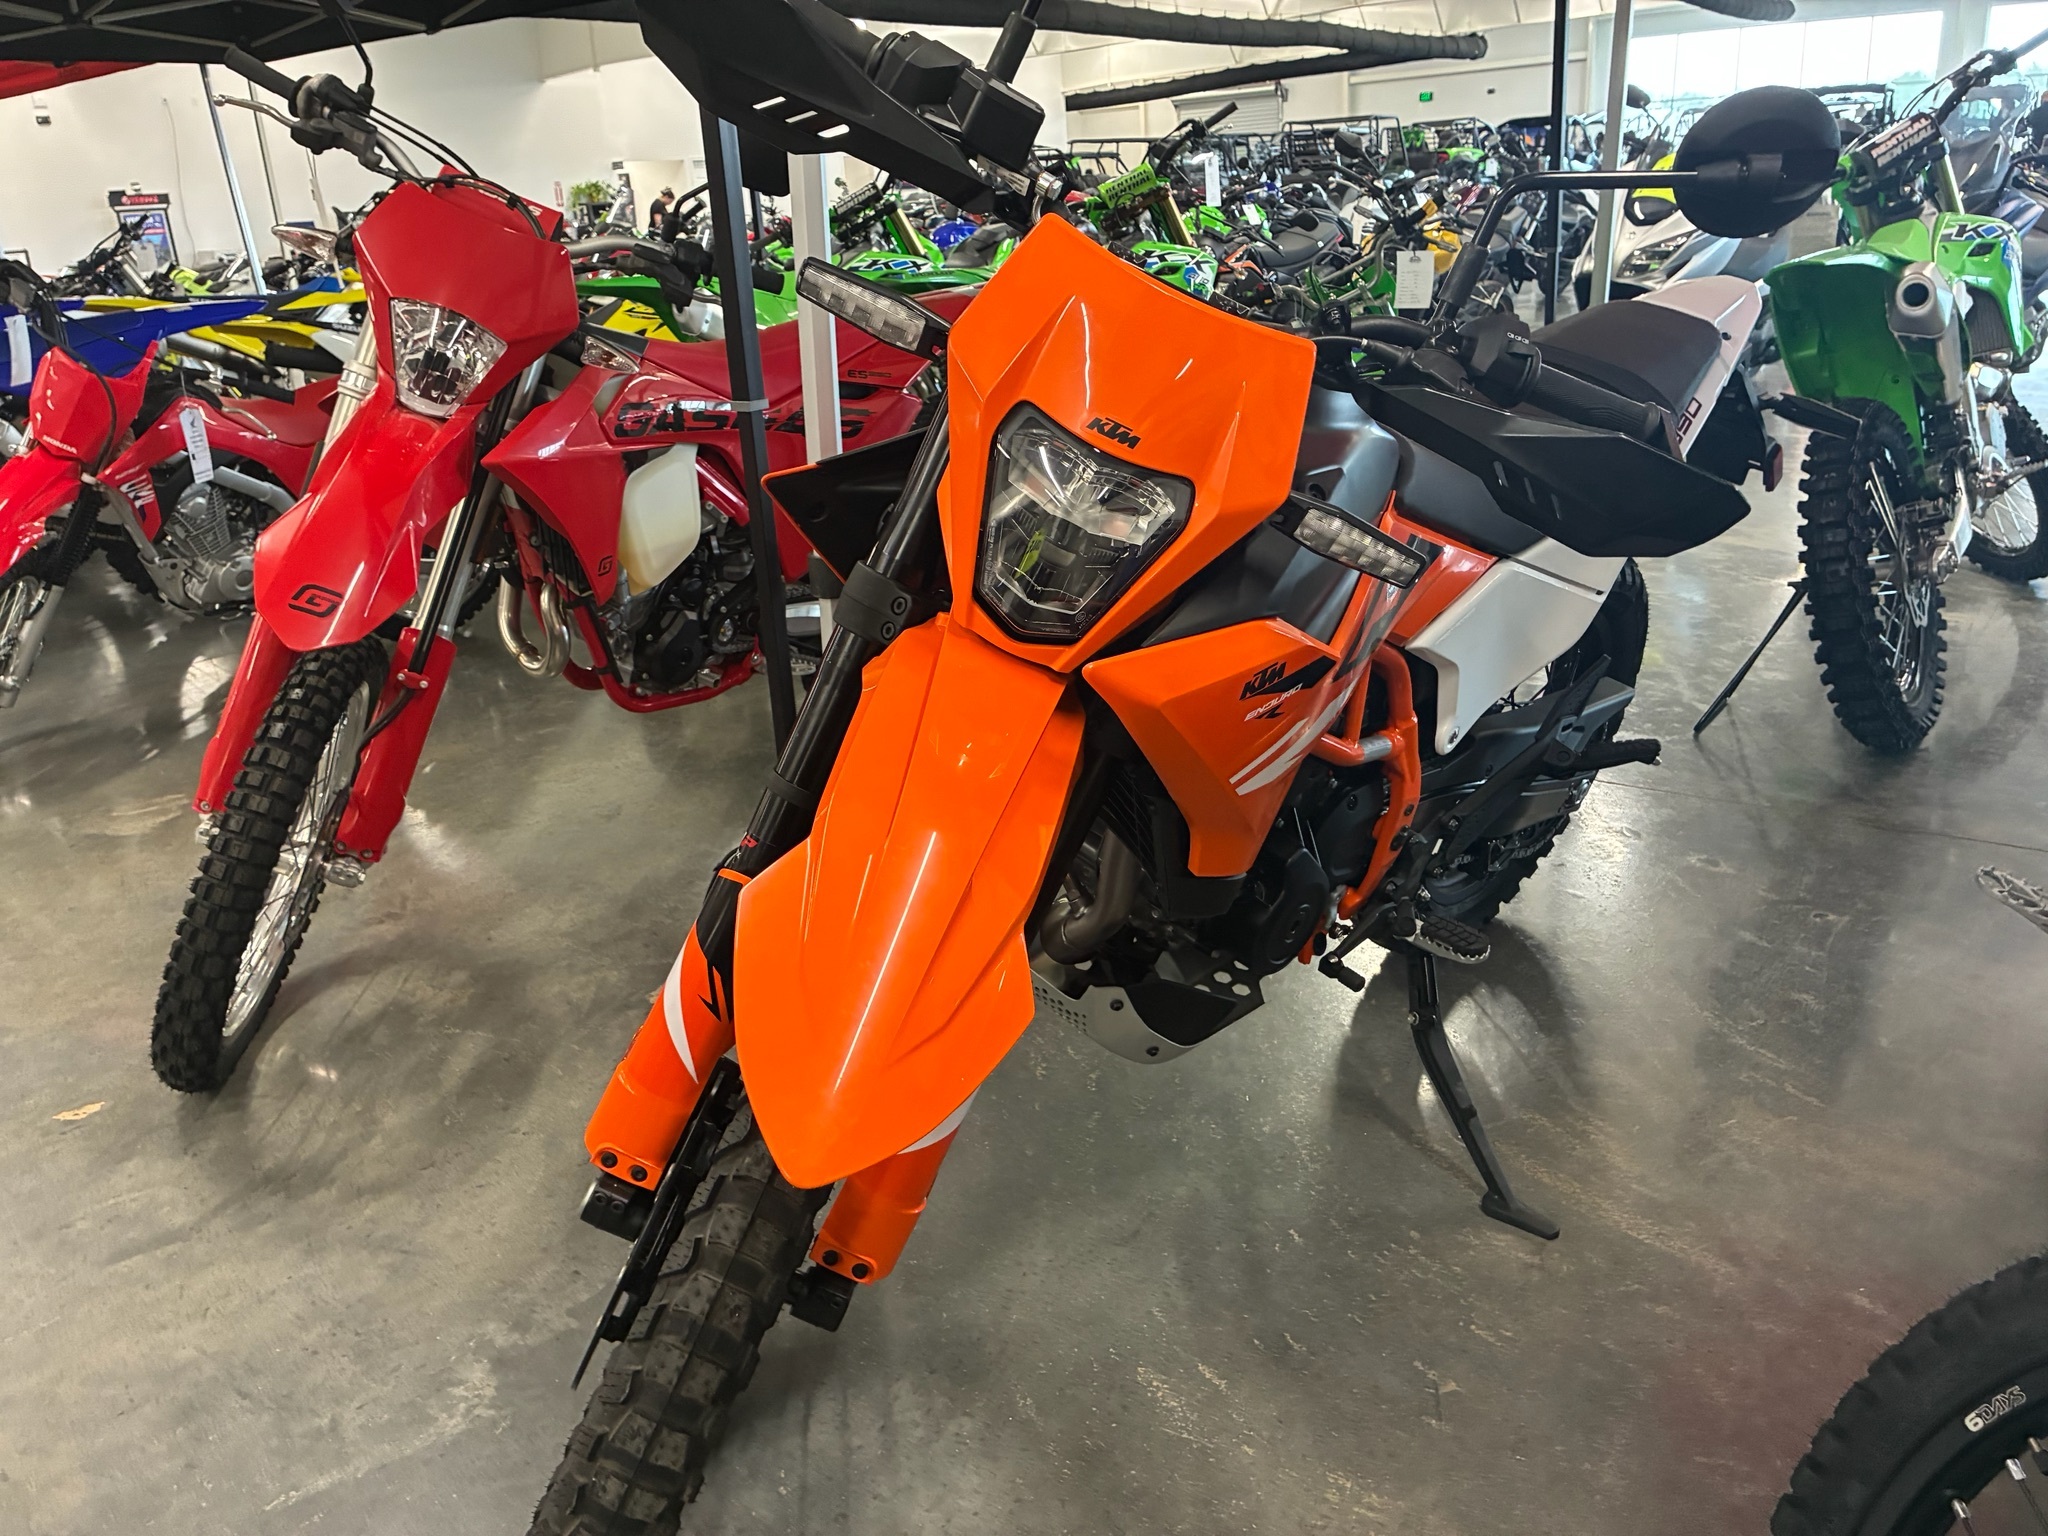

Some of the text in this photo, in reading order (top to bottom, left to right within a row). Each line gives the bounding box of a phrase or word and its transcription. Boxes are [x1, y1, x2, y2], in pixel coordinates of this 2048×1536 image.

[1086, 417, 1141, 449] KTM
[1676, 397, 1702, 445] 90
[42, 434, 78, 455] HONDA
[1239, 661, 1287, 701] KTM
[1244, 682, 1303, 722] ENDURO
[1964, 1385, 2027, 1432] 6DAYS
